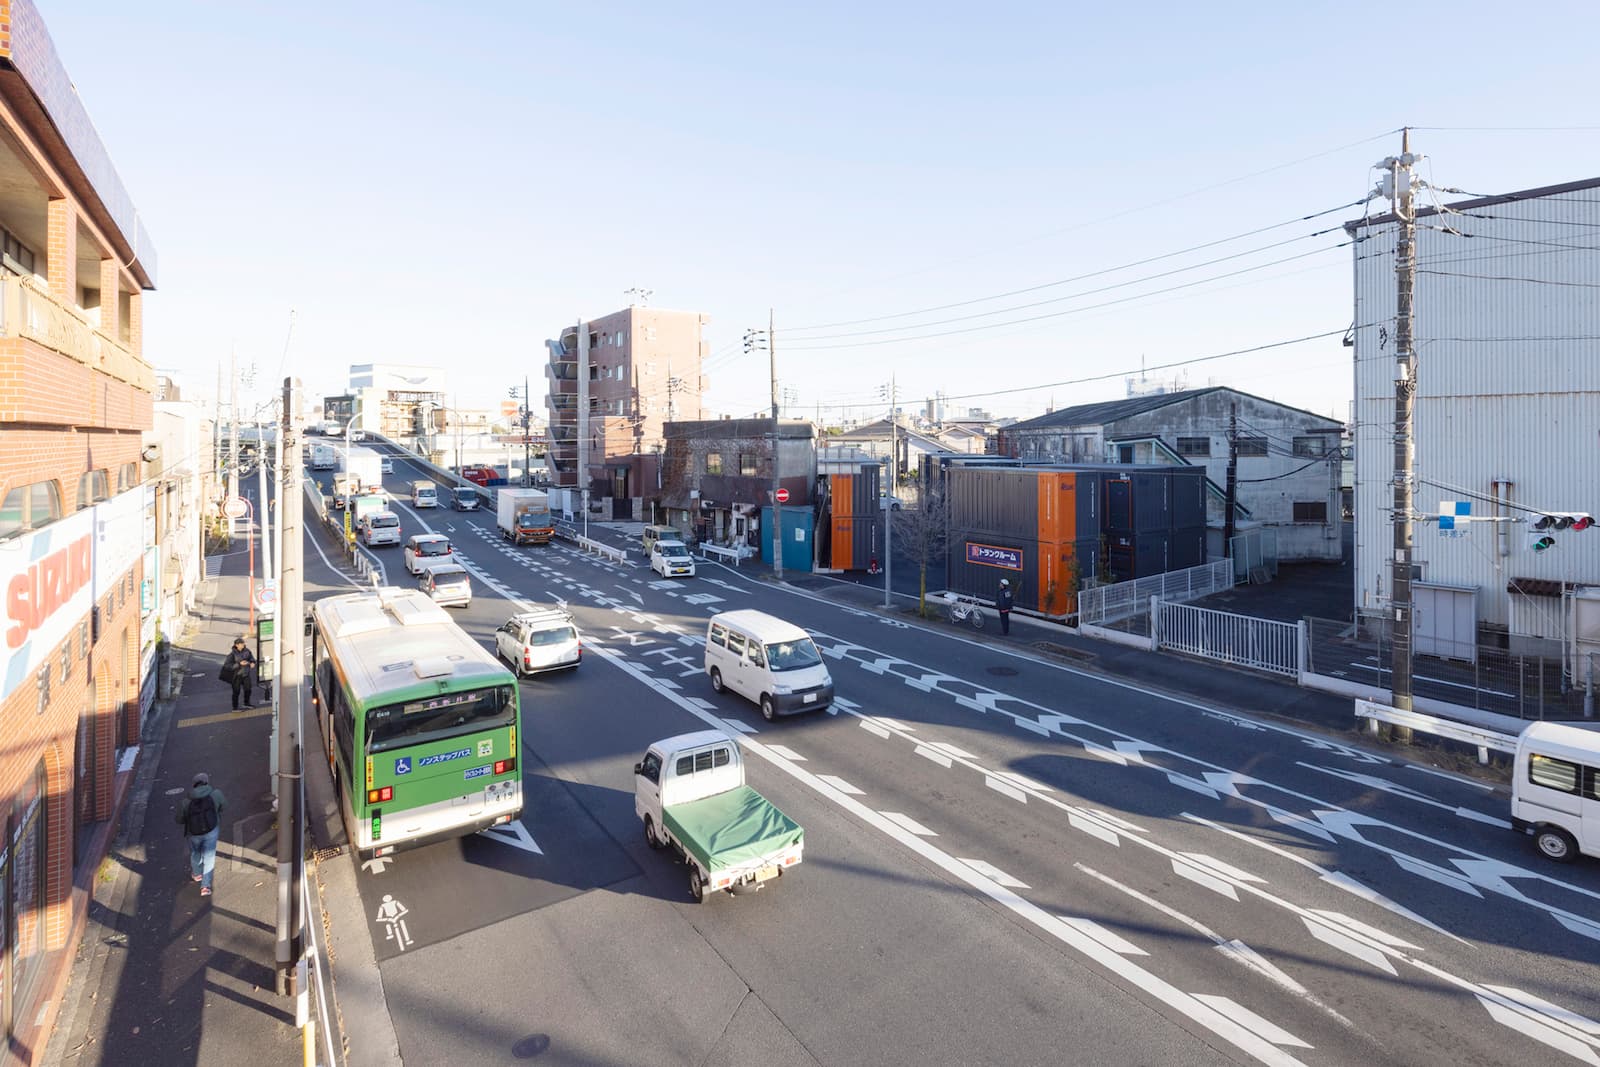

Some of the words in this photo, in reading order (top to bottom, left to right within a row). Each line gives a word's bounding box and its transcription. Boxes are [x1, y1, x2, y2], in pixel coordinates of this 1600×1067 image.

[6, 534, 91, 648] SUZUKI
[420, 749, 471, 766] ノンステップバス
